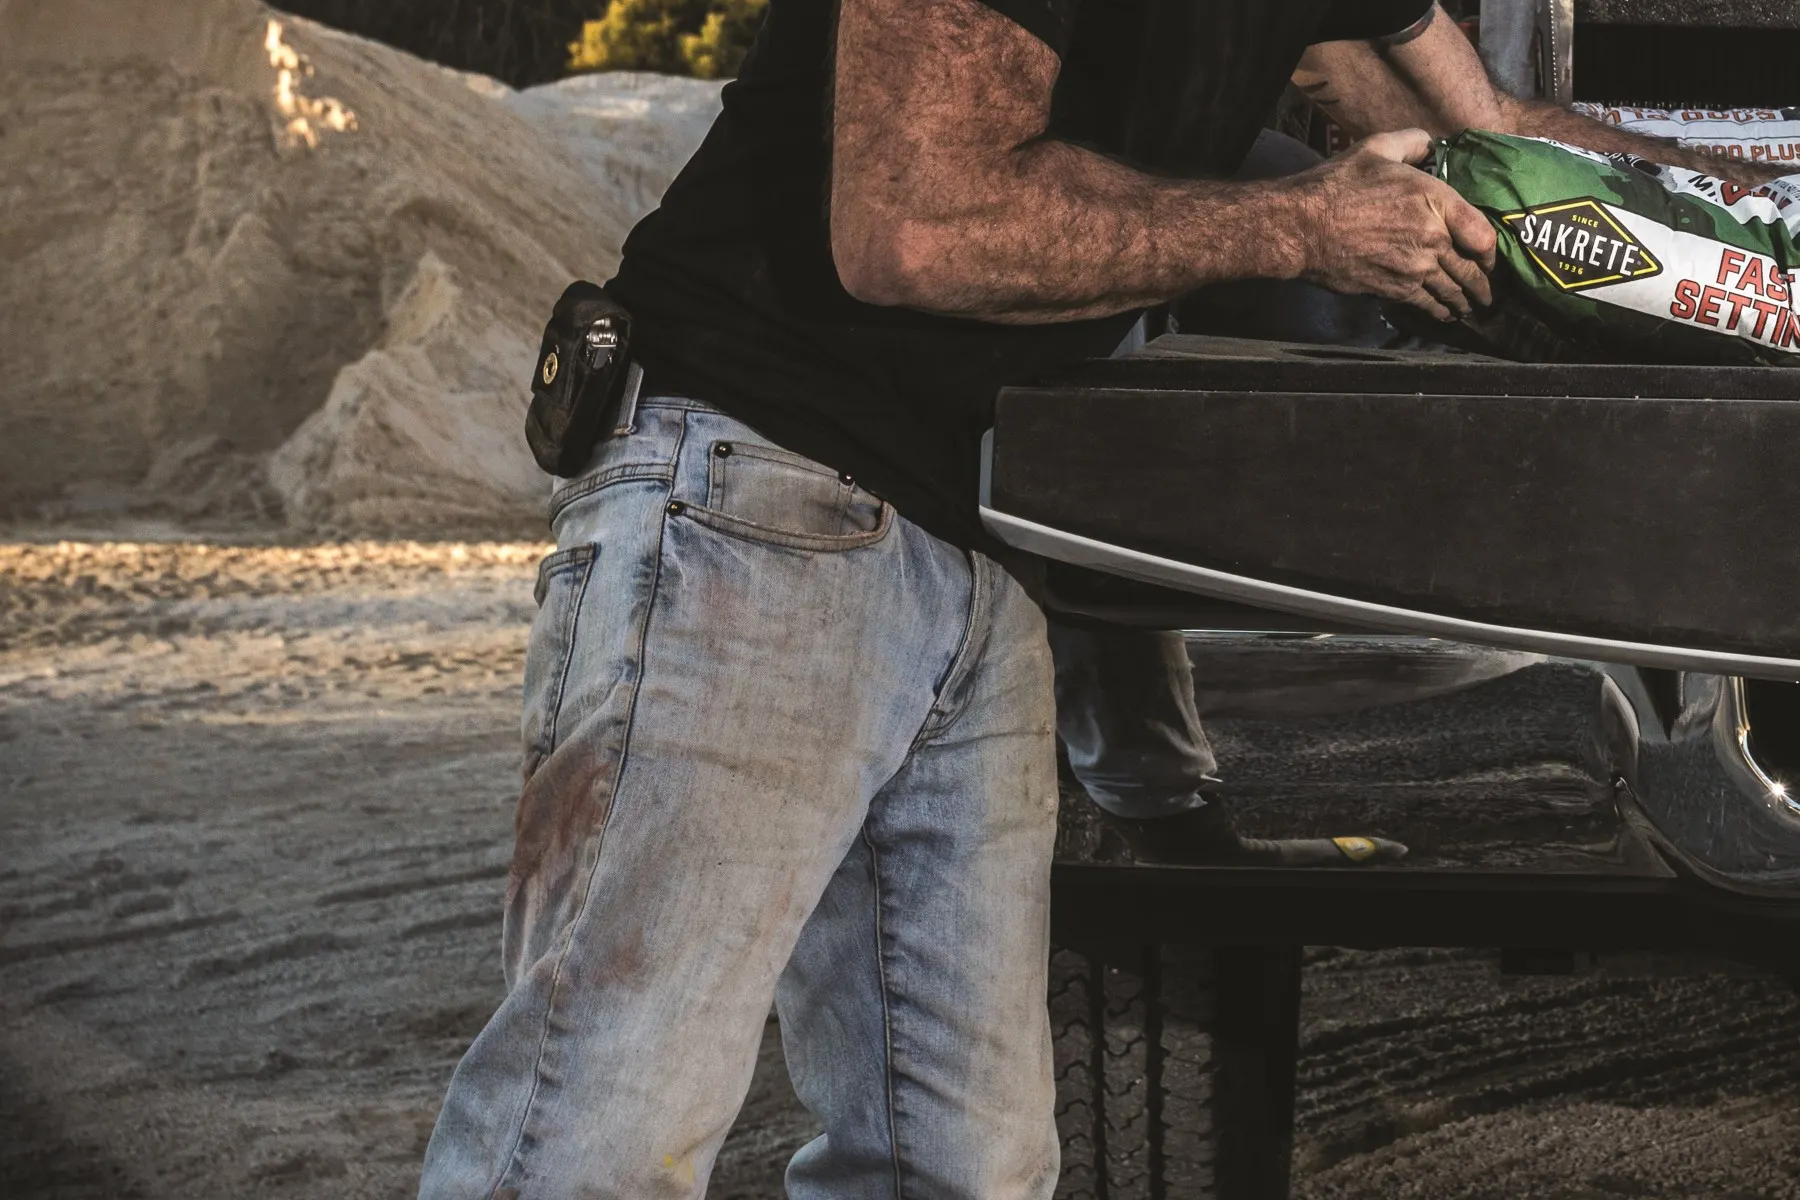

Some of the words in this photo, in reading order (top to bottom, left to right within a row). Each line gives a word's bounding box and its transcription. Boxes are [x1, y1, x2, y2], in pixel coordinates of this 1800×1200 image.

[1572, 214, 1599, 228] SINCE
[1520, 214, 1639, 276] SAKRETE
[1558, 261, 1584, 276] 1936
[1716, 248, 1795, 301] FAS
